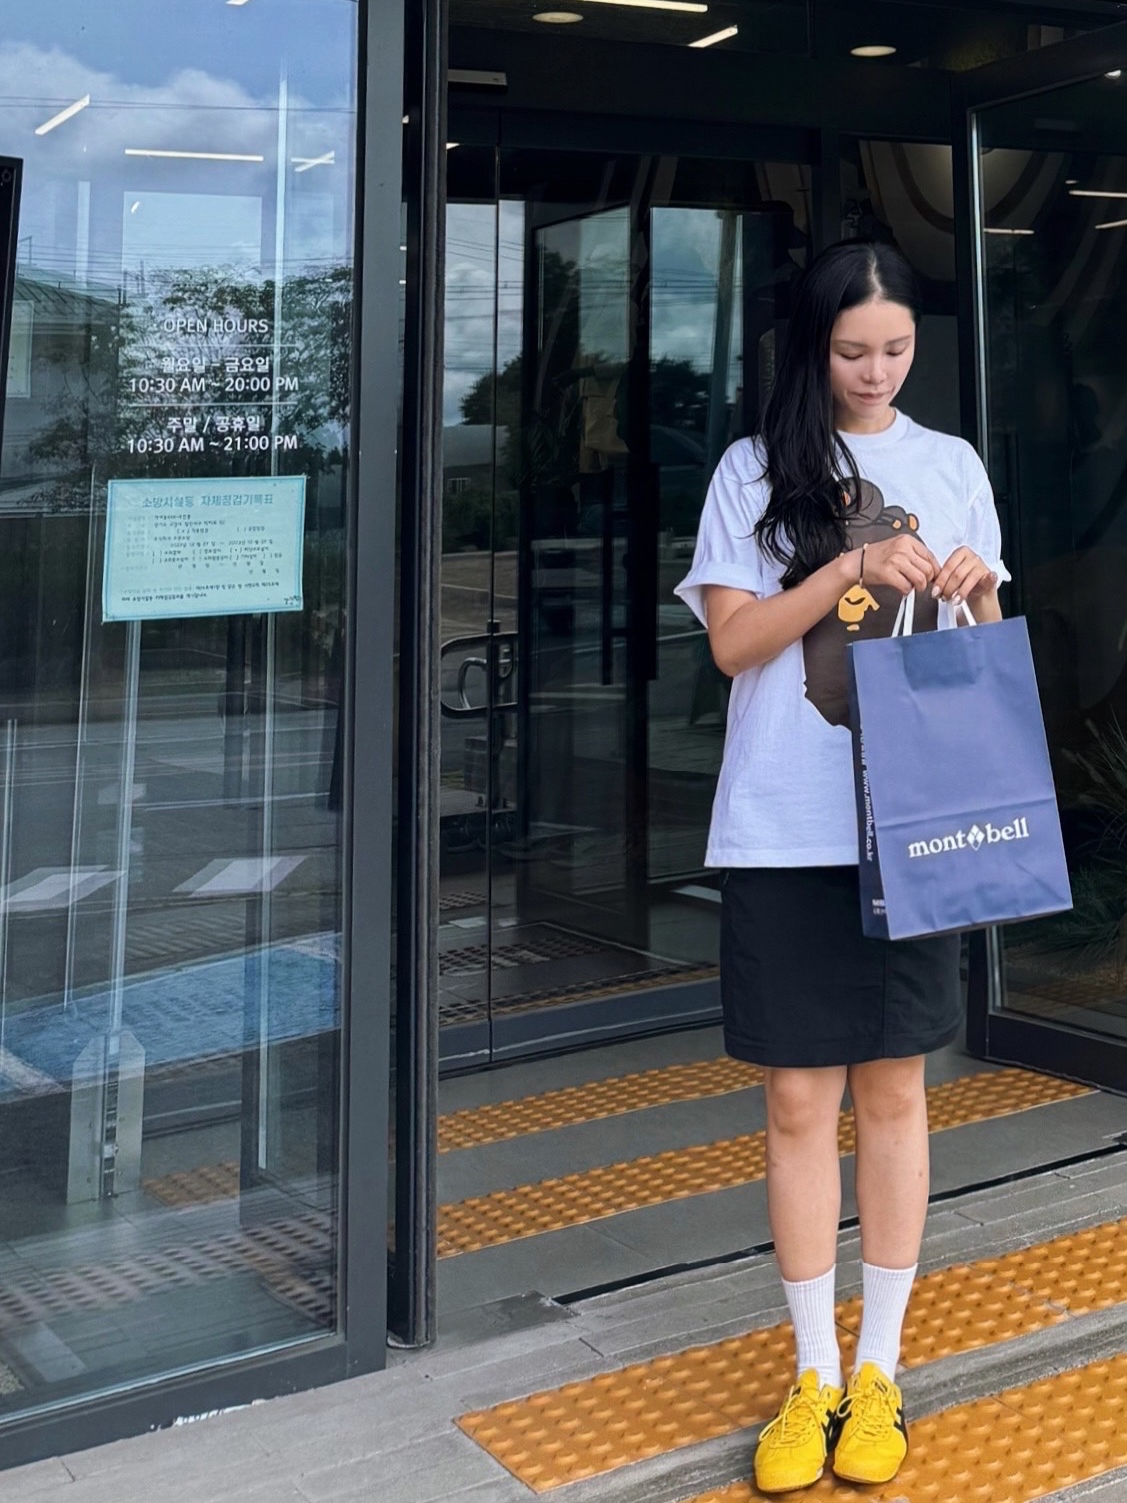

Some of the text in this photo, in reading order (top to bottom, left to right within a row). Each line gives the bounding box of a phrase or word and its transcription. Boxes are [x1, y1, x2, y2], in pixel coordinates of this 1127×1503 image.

[163, 318, 269, 333] OPEN HOURS
[162, 356, 206, 373] 월요일
[224, 356, 270, 373] 금요일
[129, 377, 176, 393] 10:30
[180, 377, 206, 392] AM
[225, 376, 270, 392] 20:00
[275, 376, 299, 391] PM
[166, 416, 197, 433] 주말
[215, 415, 261, 432] 공휴일
[127, 438, 175, 453] 10:30
[178, 437, 205, 452] AM
[223, 435, 270, 451] 21:00
[274, 435, 298, 450] PM
